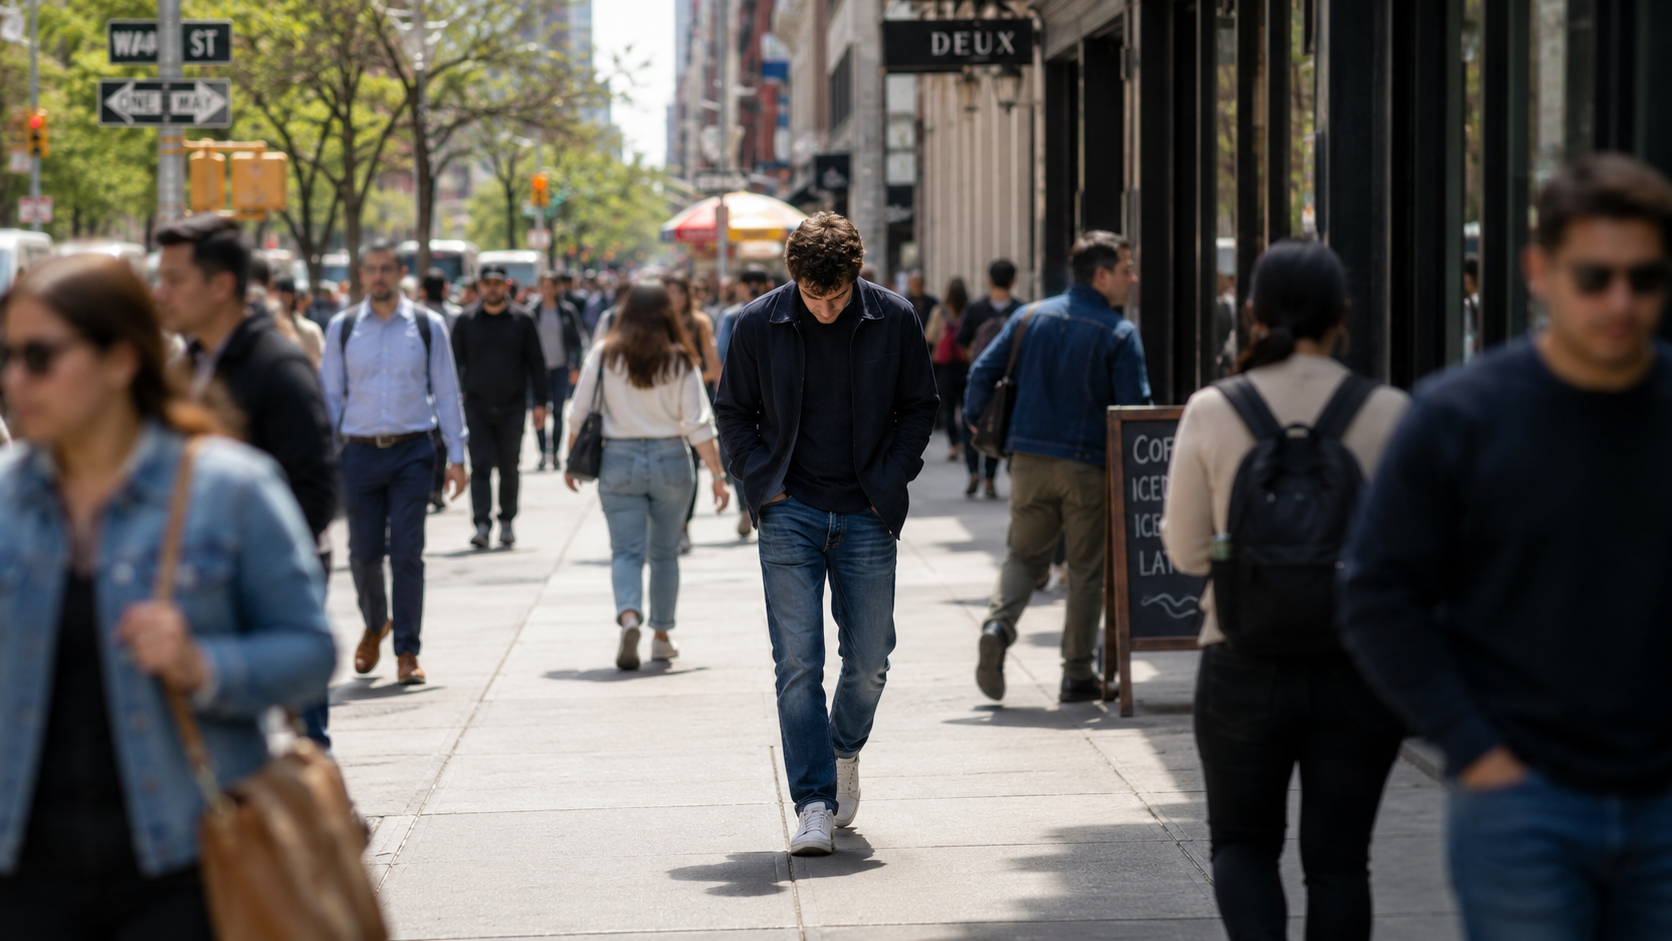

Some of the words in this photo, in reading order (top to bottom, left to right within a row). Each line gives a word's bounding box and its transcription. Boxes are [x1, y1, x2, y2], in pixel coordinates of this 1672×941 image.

[190, 29, 219, 57] ST
[930, 31, 1015, 56] DEUX
[117, 91, 157, 113] ONE
